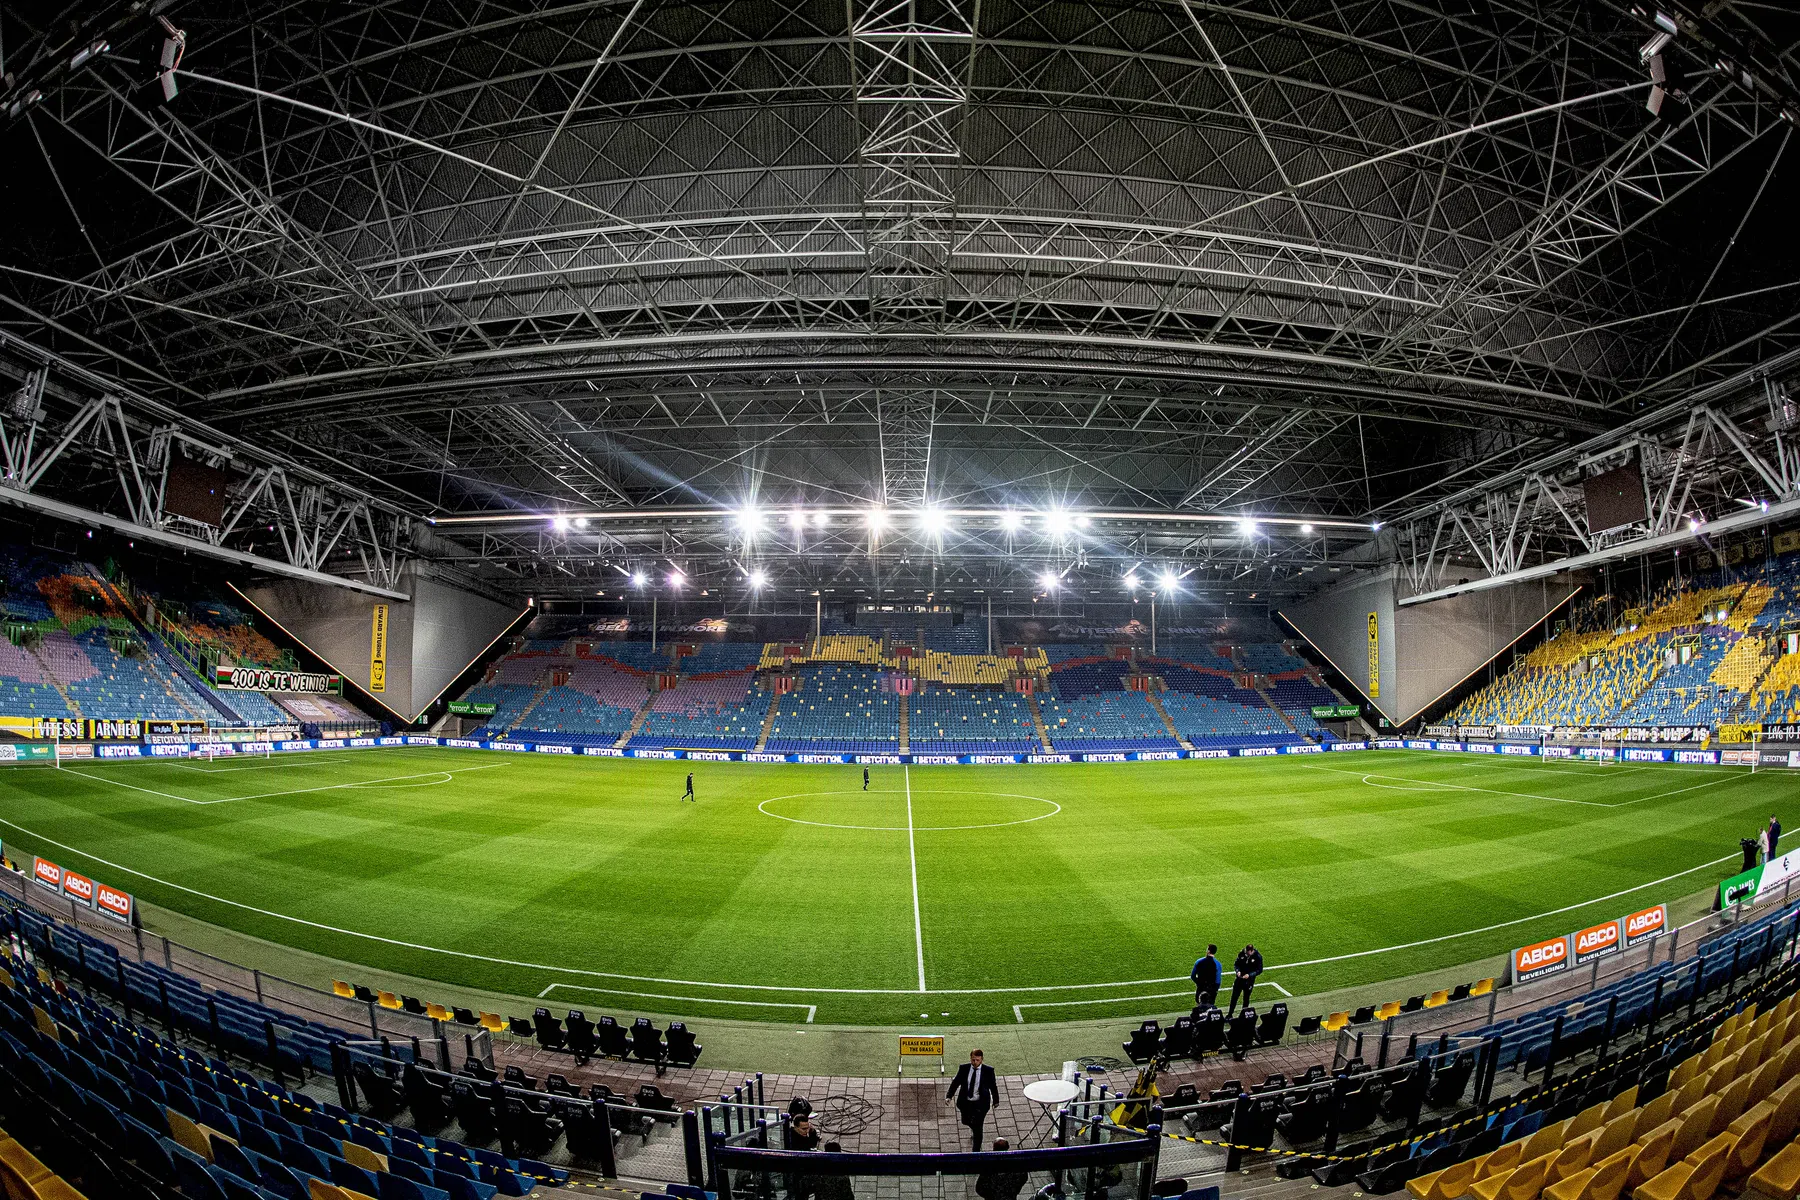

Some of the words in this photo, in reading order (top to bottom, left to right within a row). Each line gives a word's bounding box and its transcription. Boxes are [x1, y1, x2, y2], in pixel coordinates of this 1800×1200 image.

[231, 669, 255, 688] 400
[259, 672, 271, 690] IS
[274, 673, 288, 691] TE
[290, 675, 330, 692] WEINIG!
[38, 722, 84, 737] VITESSE
[97, 723, 140, 737] ARNHEM
[37, 862, 59, 880] ABCO
[65, 875, 92, 895] ABCO
[99, 890, 128, 911] ABCO
[1628, 910, 1662, 933] ABCO
[1578, 926, 1616, 950] ABCO
[1629, 930, 1663, 946] BEVEILIGING
[1520, 942, 1564, 967] ABCO
[1579, 946, 1617, 963] BEVEILIGING
[1521, 963, 1565, 981] BEVEILIGING
